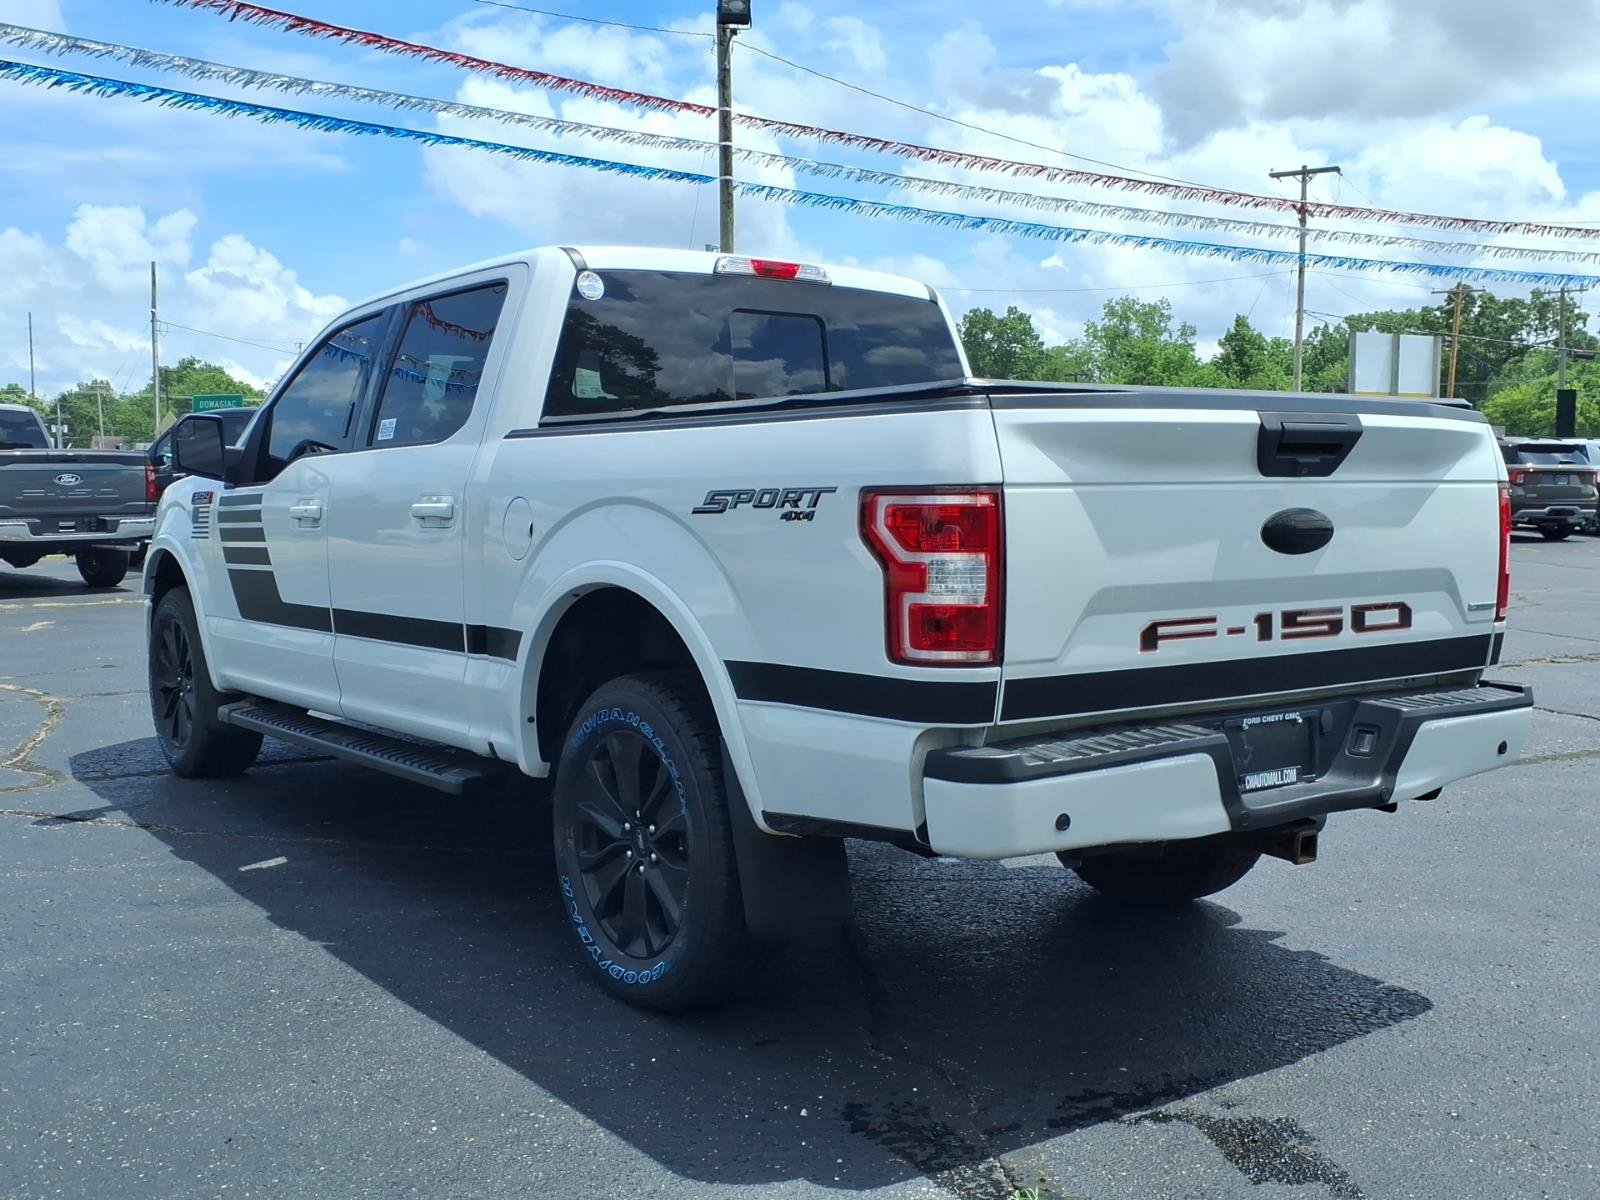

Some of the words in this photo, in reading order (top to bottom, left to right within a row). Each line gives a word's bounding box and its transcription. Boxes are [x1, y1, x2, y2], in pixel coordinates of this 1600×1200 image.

[199, 400, 237, 409] DOWAGIAC
[692, 486, 838, 515] SPORT
[1139, 600, 1413, 653] F-150
[1262, 714, 1284, 722] CHEVY
[1285, 712, 1300, 720] GMC
[561, 875, 665, 984] GOODYEAR
